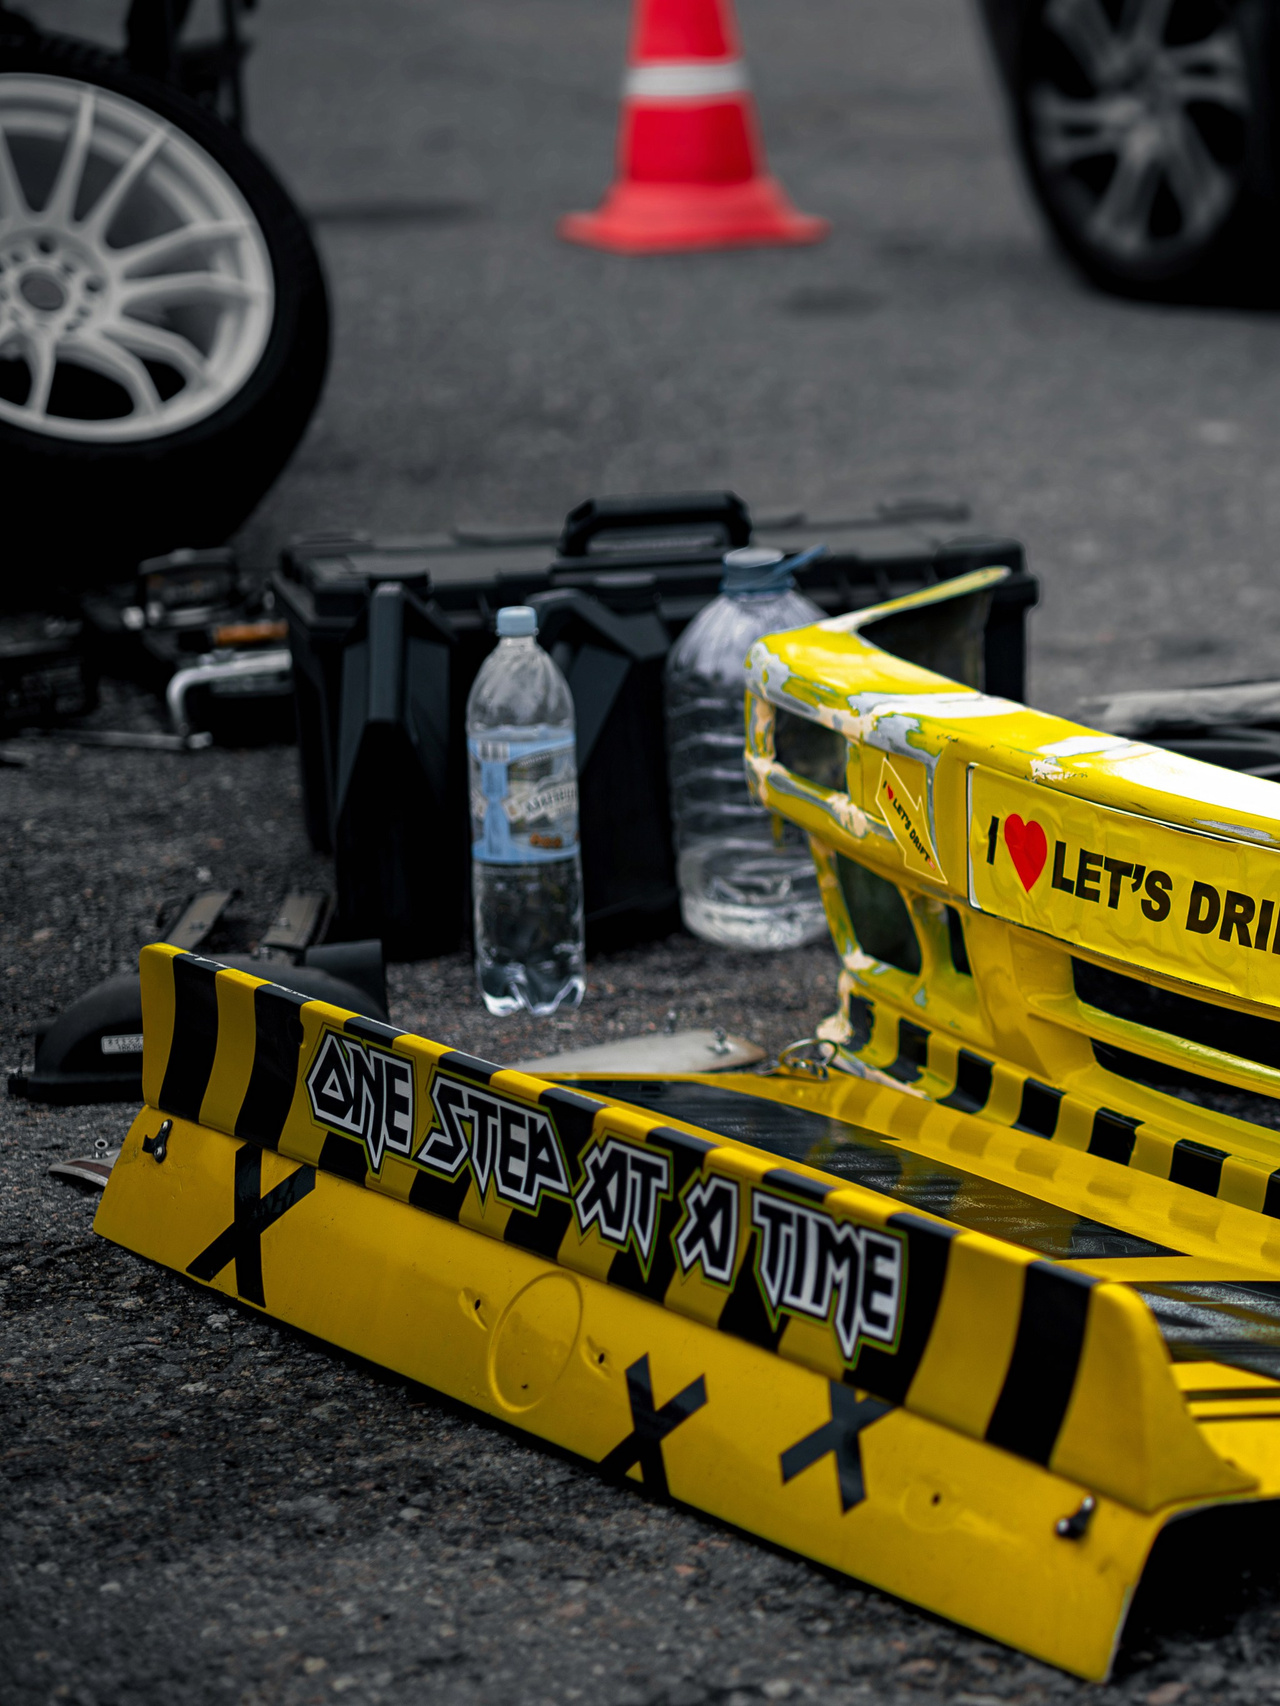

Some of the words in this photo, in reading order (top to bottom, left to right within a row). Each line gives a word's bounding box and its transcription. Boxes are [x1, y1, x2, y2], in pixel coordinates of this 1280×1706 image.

[883, 781, 888, 789] I
[893, 798, 912, 831] LET'S
[986, 815, 1000, 865] I
[1051, 841, 1173, 922] LET'S
[306, 1032, 414, 1173] ONE
[415, 1074, 571, 1207] STEP
[574, 1138, 669, 1260] AT
[675, 1175, 739, 1284] A
[752, 1189, 903, 1360] TIME
